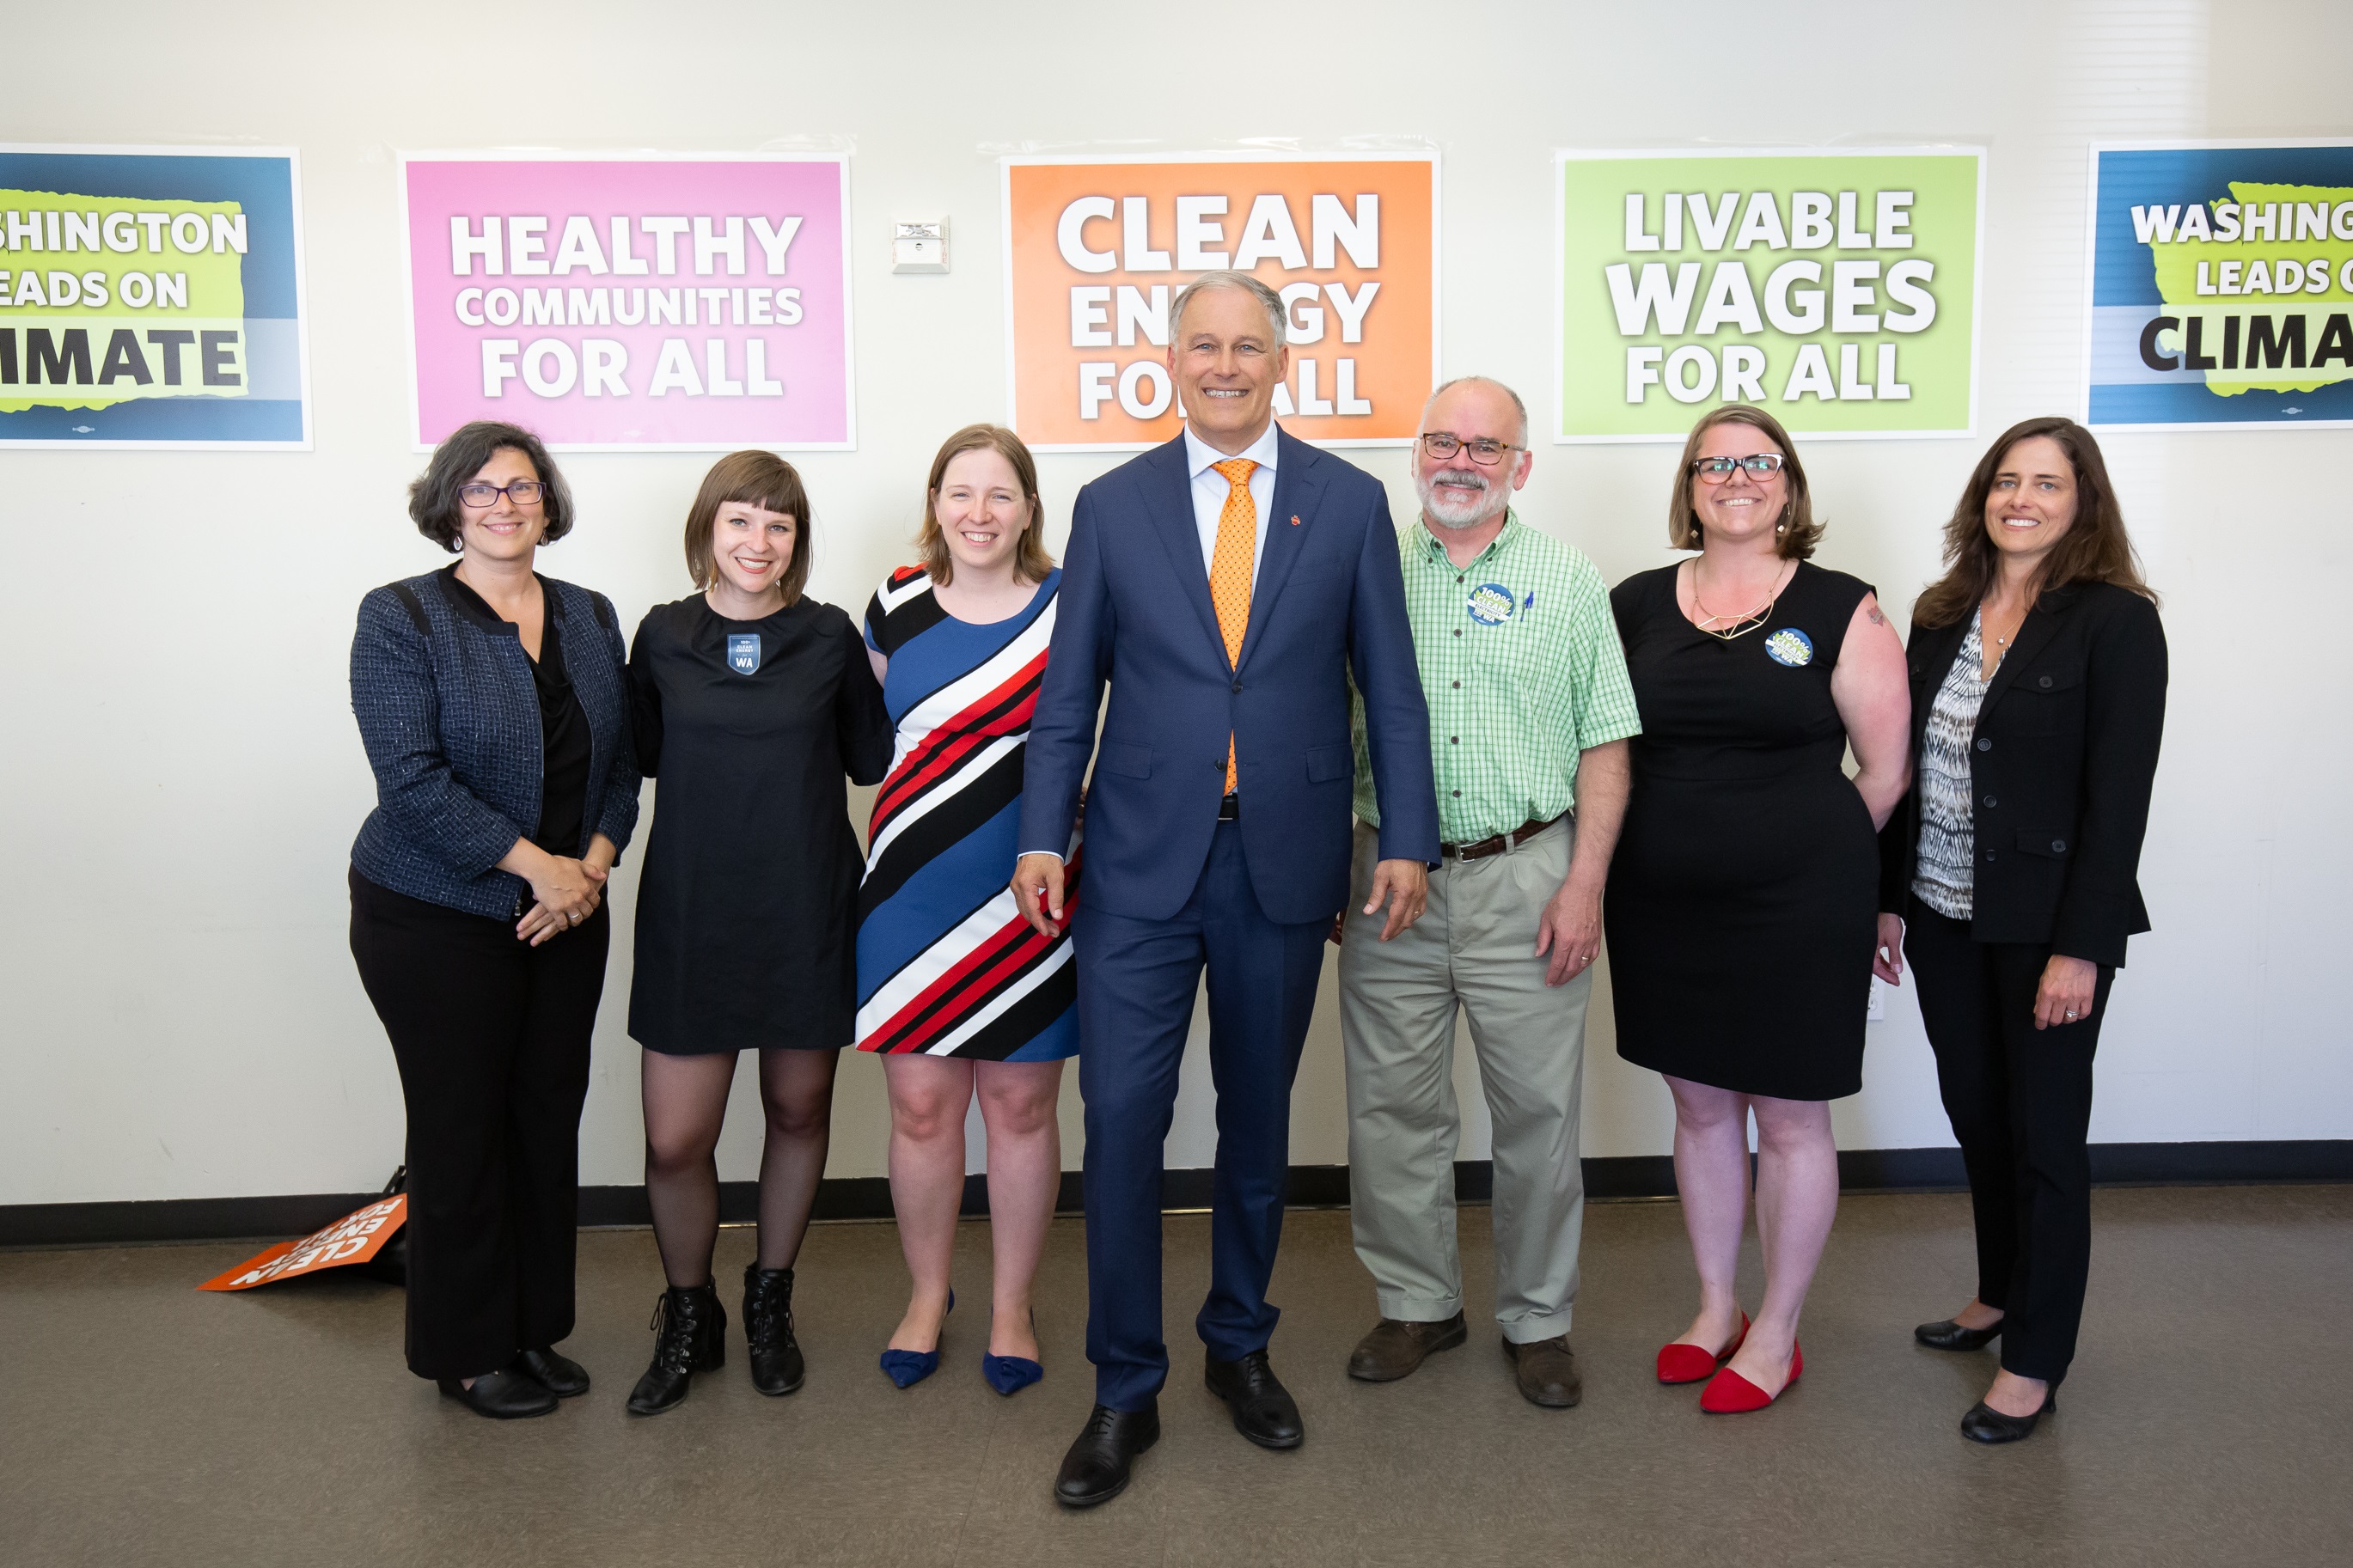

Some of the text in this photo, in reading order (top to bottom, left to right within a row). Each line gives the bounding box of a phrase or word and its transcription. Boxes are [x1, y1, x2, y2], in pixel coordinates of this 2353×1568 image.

[0, 210, 248, 253] HINGTON
[1057, 193, 1379, 273] CLEAN
[1625, 190, 1915, 252] LIVABLE
[2130, 201, 2353, 244] WASHING
[450, 216, 803, 276] HEALTHY
[119, 272, 188, 308] ON
[1604, 259, 1936, 336] WAGES
[2197, 259, 2330, 296] LEADS
[455, 287, 803, 326] COMMUNITIES
[1071, 282, 1381, 347] ENGY
[0, 327, 241, 387] IMATE
[2139, 313, 2353, 372] CLIMA
[481, 339, 783, 398] FOR ALL
[1626, 343, 1911, 403] FOR ALL
[1079, 361, 1188, 420] FO
[1475, 604, 1500, 617] ELECTRICITY
[1476, 596, 1506, 614] CLEAN
[1482, 587, 1510, 606] 100%
[1483, 614, 1494, 623] WA
[736, 657, 753, 668] WA
[1775, 638, 1804, 658] CLEAN
[1782, 631, 1809, 653] 100%
[1782, 654, 1793, 664] WA
[229, 1235, 369, 1285] CLEAN
